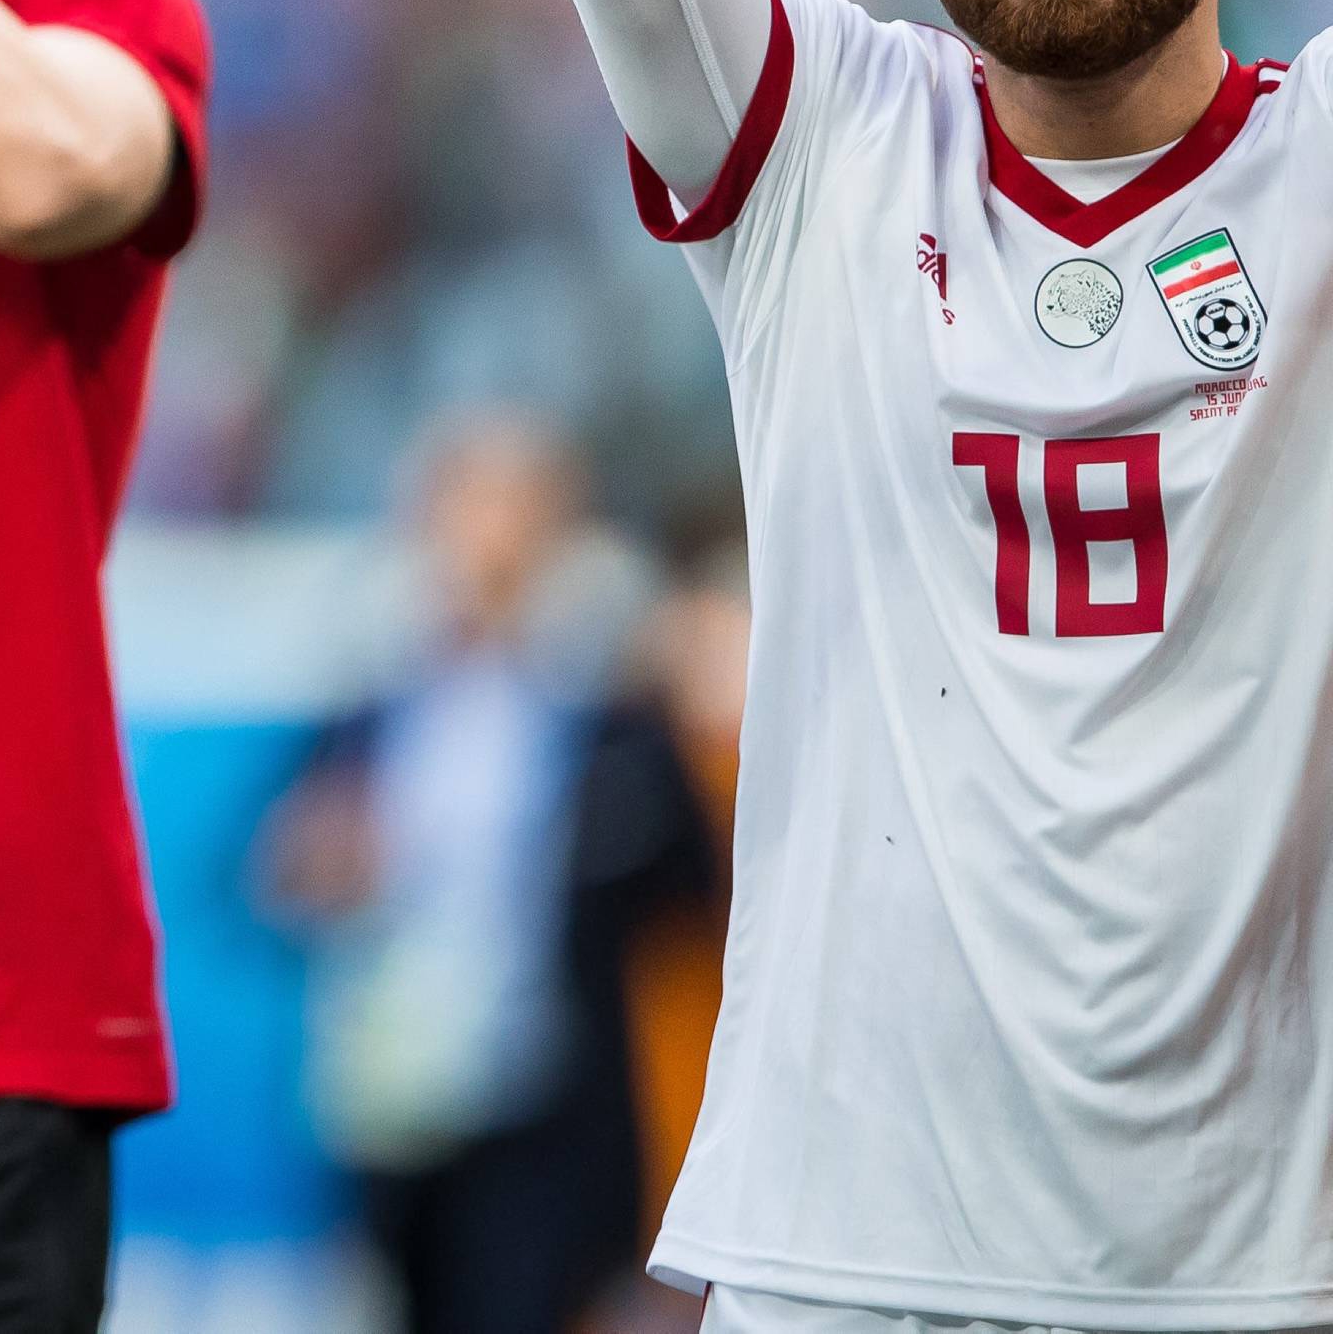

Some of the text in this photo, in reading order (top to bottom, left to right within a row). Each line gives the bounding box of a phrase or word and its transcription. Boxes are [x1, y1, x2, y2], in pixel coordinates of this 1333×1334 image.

[1194, 378, 1247, 395] MOROCCO
[1205, 394, 1218, 406] 15
[1189, 406, 1223, 422] SAINT
[952, 432, 1169, 638] 18
